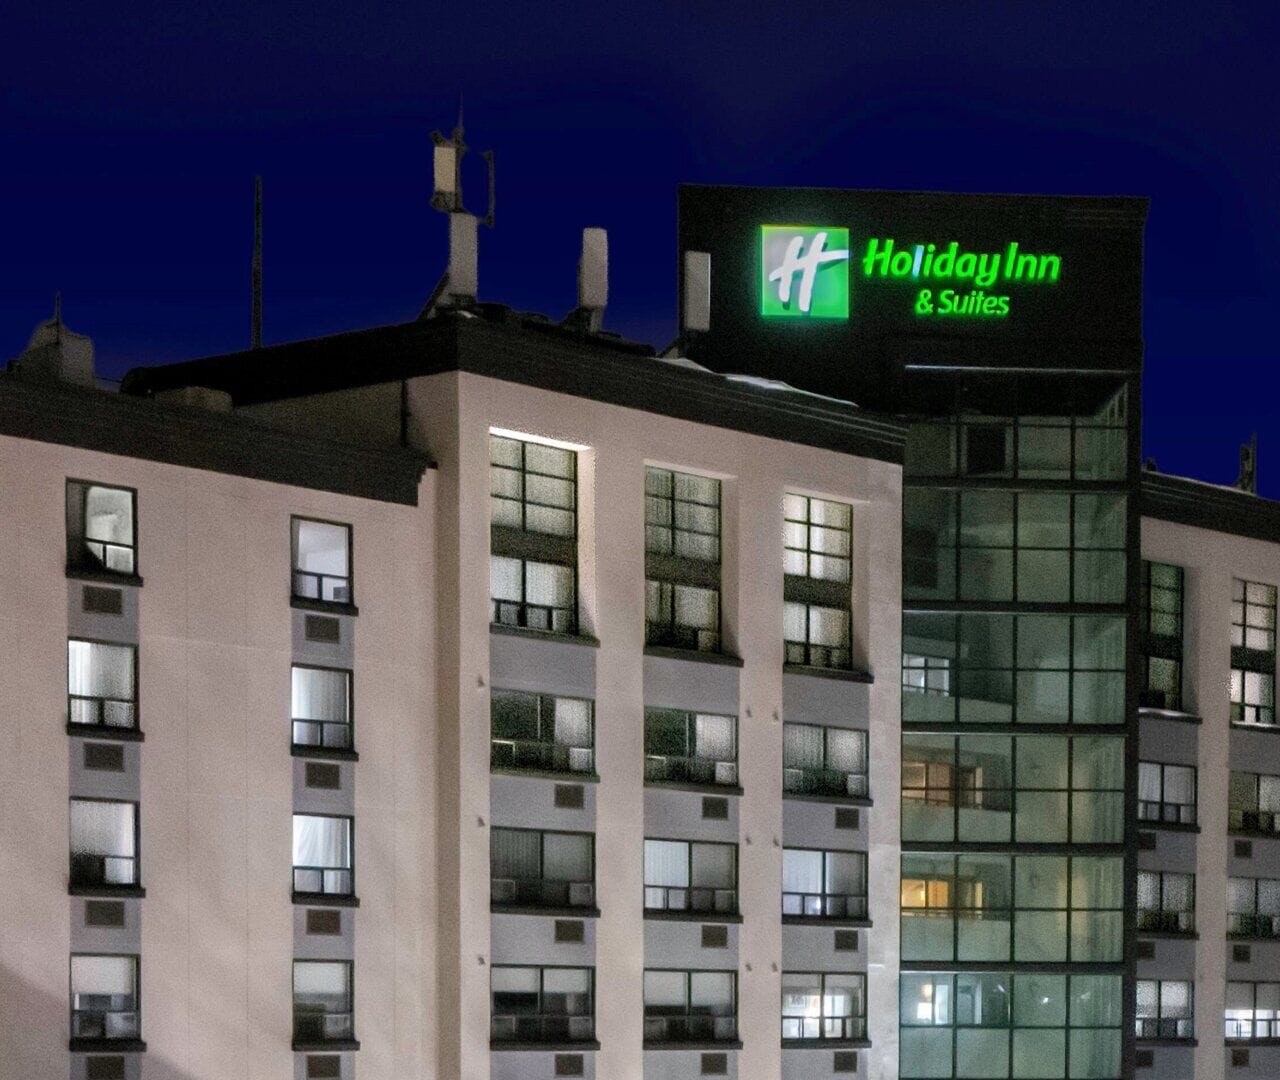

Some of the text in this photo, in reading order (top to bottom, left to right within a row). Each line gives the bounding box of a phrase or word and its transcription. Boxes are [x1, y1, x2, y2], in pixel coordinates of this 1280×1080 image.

[863, 237, 1061, 287] Holiday Inn
[917, 289, 1010, 316] & Suites
